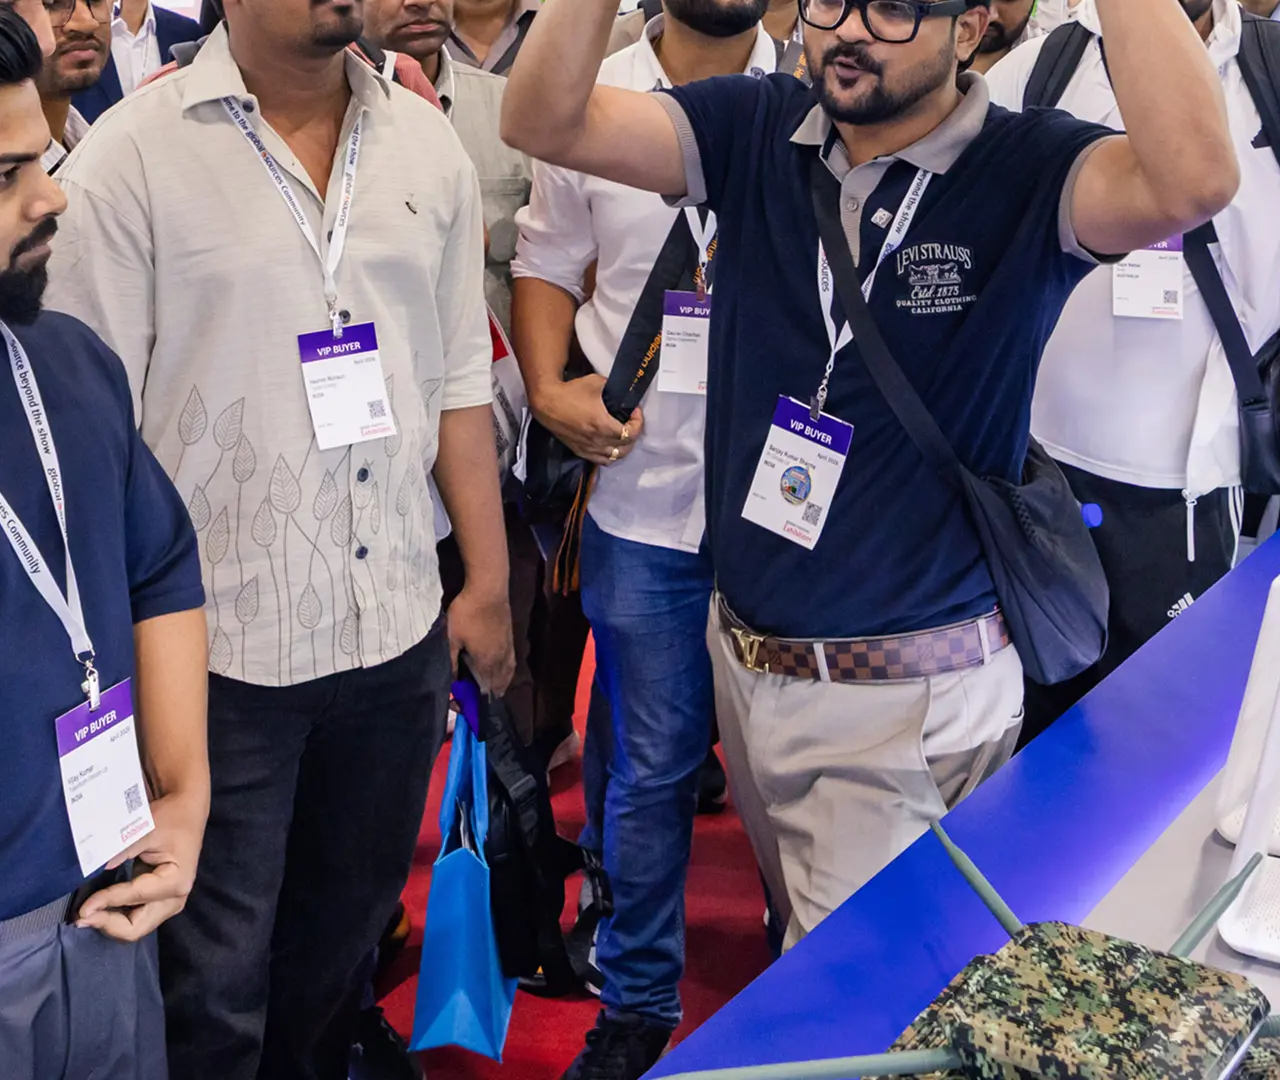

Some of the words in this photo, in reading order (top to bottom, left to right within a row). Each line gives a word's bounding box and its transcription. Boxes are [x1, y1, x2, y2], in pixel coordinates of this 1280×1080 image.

[347, 146, 358, 166] show
[238, 118, 249, 133] the
[245, 130, 266, 153] global
[264, 156, 284, 185] sources
[281, 184, 306, 226] Community
[904, 193, 918, 211] the
[895, 210, 911, 234] show
[896, 249, 920, 275] LEVI
[920, 243, 972, 269] STRAUSS
[680, 306, 694, 314] VIP
[896, 299, 931, 308] QUALITY
[935, 294, 977, 306] CLOTHING
[911, 304, 963, 315] CALIFORNIA
[317, 346, 332, 356] VIP
[333, 341, 361, 354] BUYER
[19, 371, 39, 407] beyond
[29, 405, 43, 426] the
[37, 427, 52, 455] show
[790, 419, 804, 432] VIP
[804, 425, 832, 445] BUYER
[46, 467, 62, 501] global
[6, 518, 42, 575] Community
[74, 724, 89, 742] VIP
[90, 710, 117, 736] BUYER
